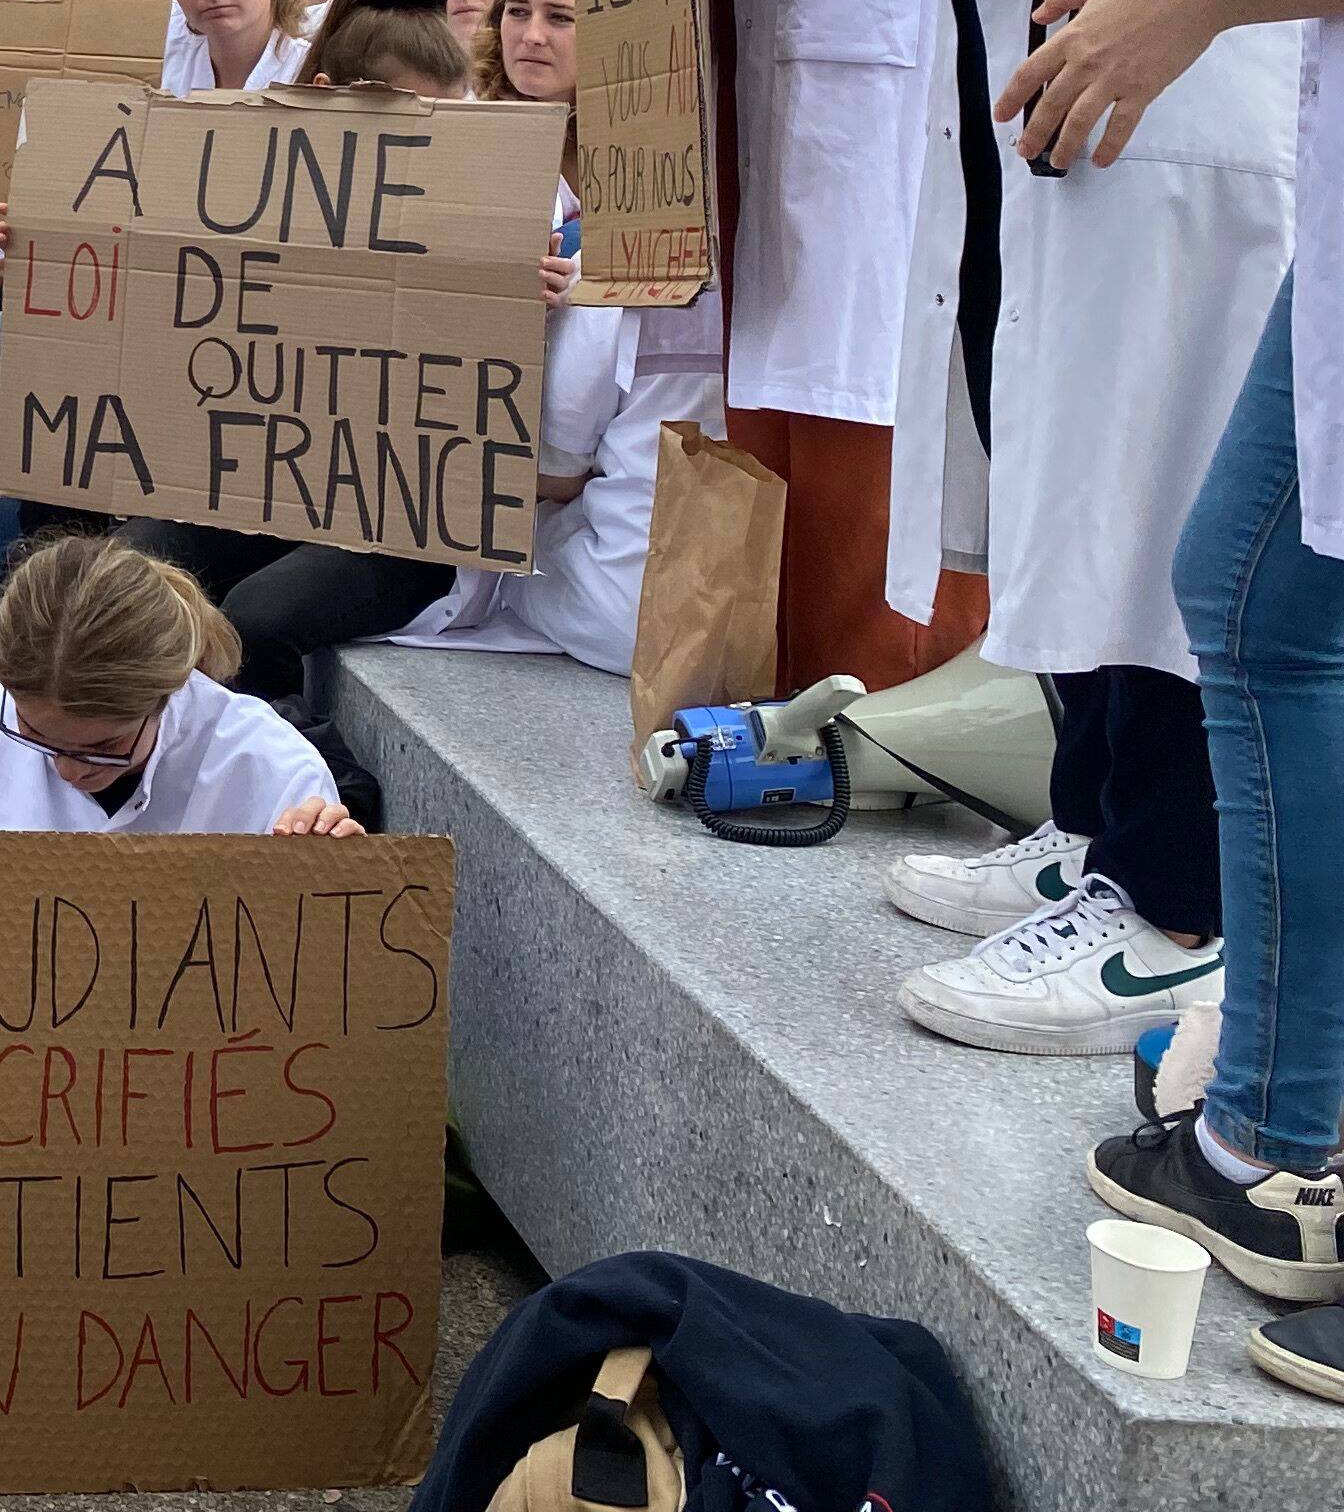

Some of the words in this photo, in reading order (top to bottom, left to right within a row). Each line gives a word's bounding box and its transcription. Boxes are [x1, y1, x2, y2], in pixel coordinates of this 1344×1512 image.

[603, 39, 651, 128] VOUS
[72, 102, 144, 220] À
[197, 125, 433, 254] UNE
[578, 144, 601, 220] PAS
[608, 144, 646, 215] POUR
[652, 143, 695, 208] NOUS
[173, 246, 281, 337] DE
[187, 336, 532, 445] QUITTER
[21, 391, 155, 496] MA
[207, 410, 534, 565] FRANCE
[1294, 1187, 1336, 1207] NIKE
[76, 1291, 423, 1410] DANGER
